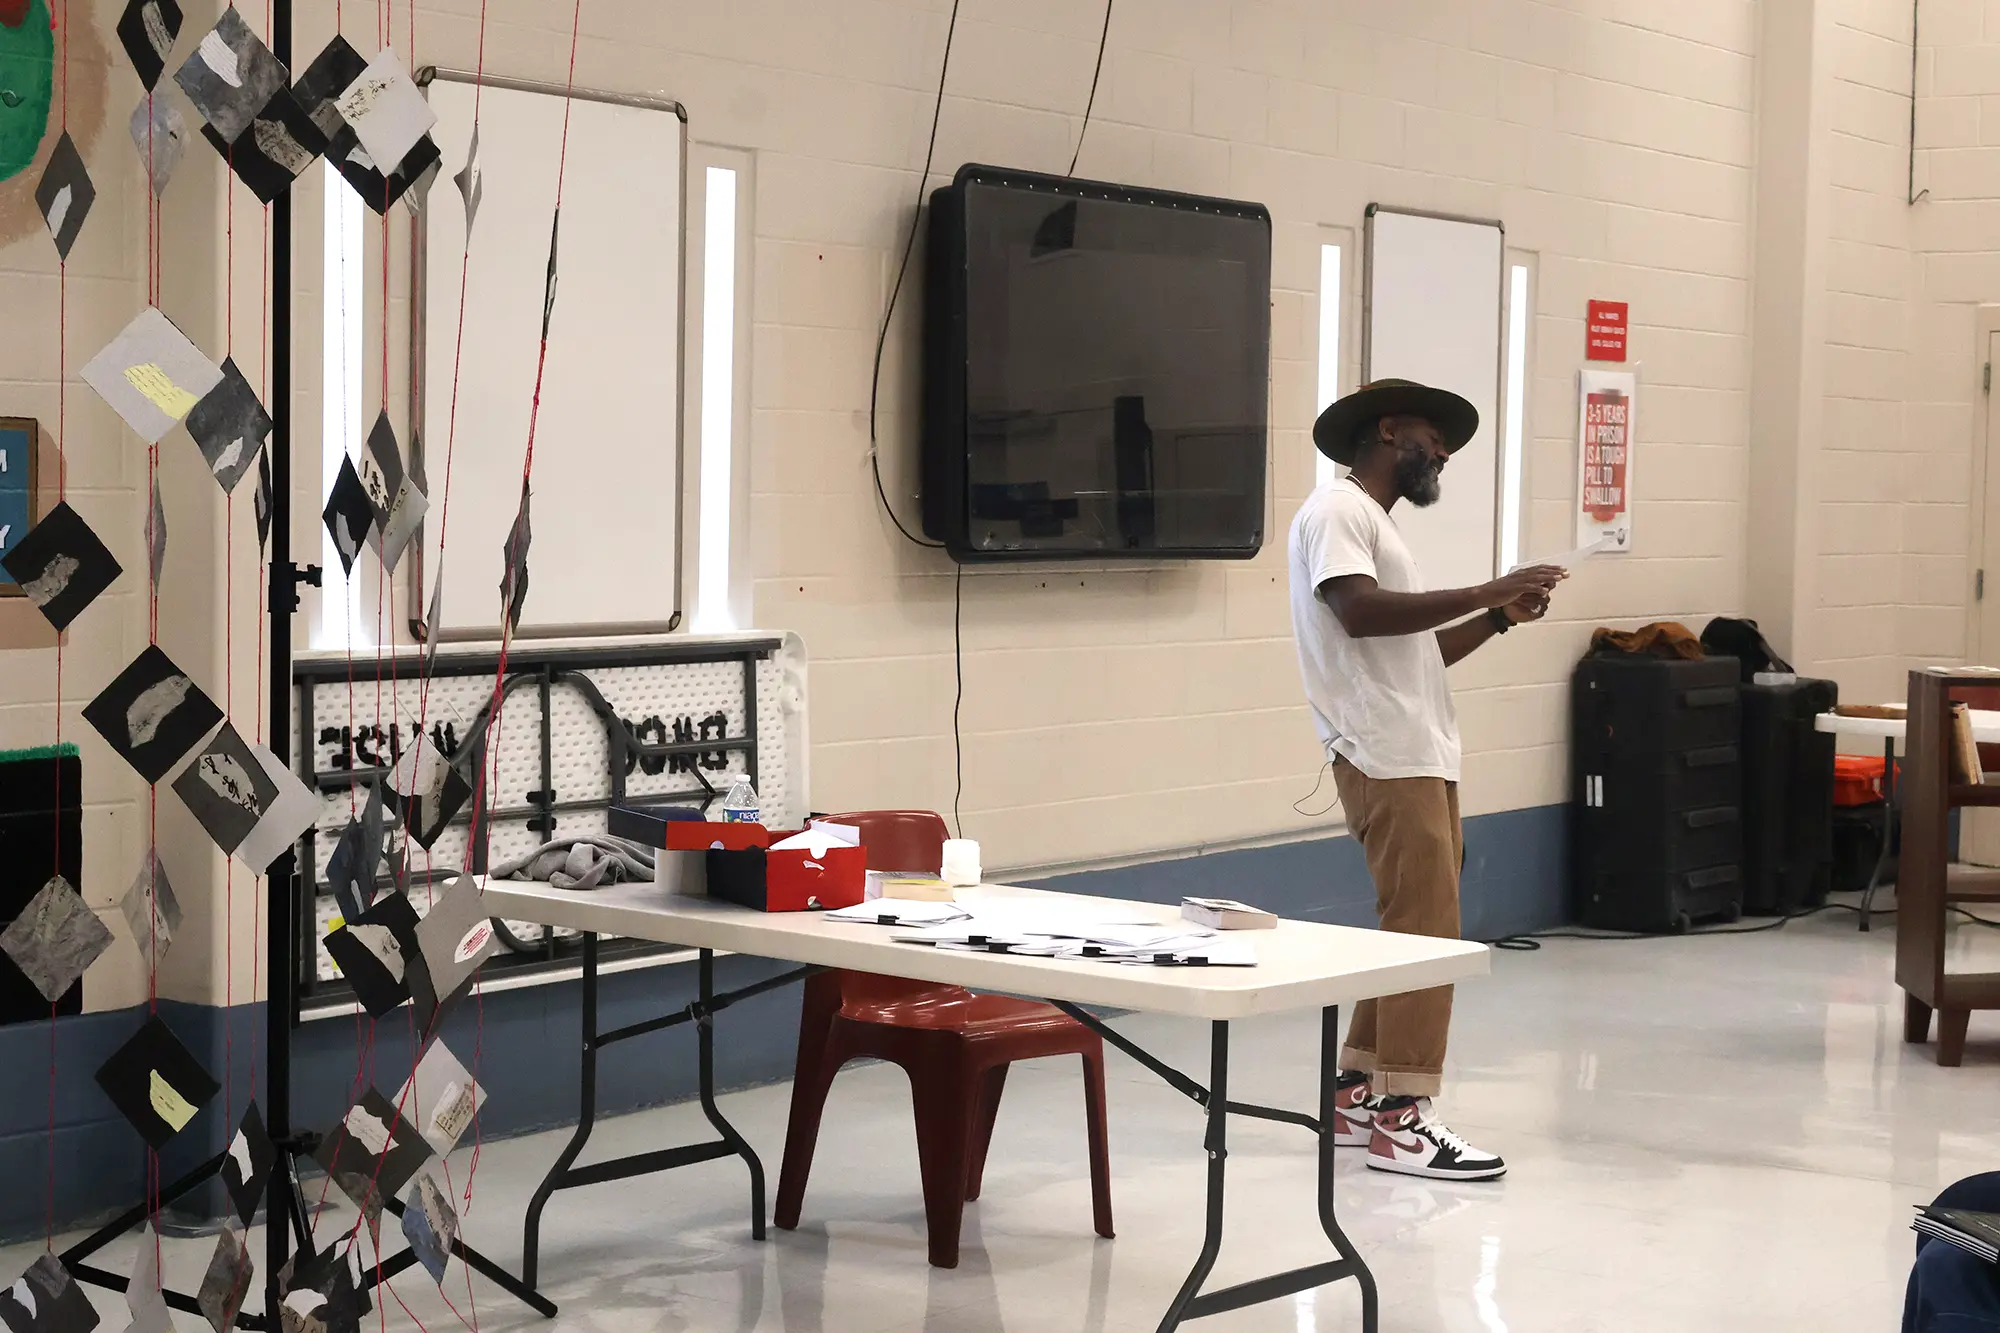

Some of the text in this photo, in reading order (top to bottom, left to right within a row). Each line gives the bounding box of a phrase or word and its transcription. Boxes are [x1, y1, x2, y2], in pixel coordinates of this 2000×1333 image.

[1587, 404, 1626, 424] 3-5 YEARS
[1587, 424, 1625, 444] IN PRISON
[1586, 445, 1625, 465] IS A TOUGH
[1585, 466, 1614, 485] PILL TO
[1584, 487, 1622, 506] SWALLOW
